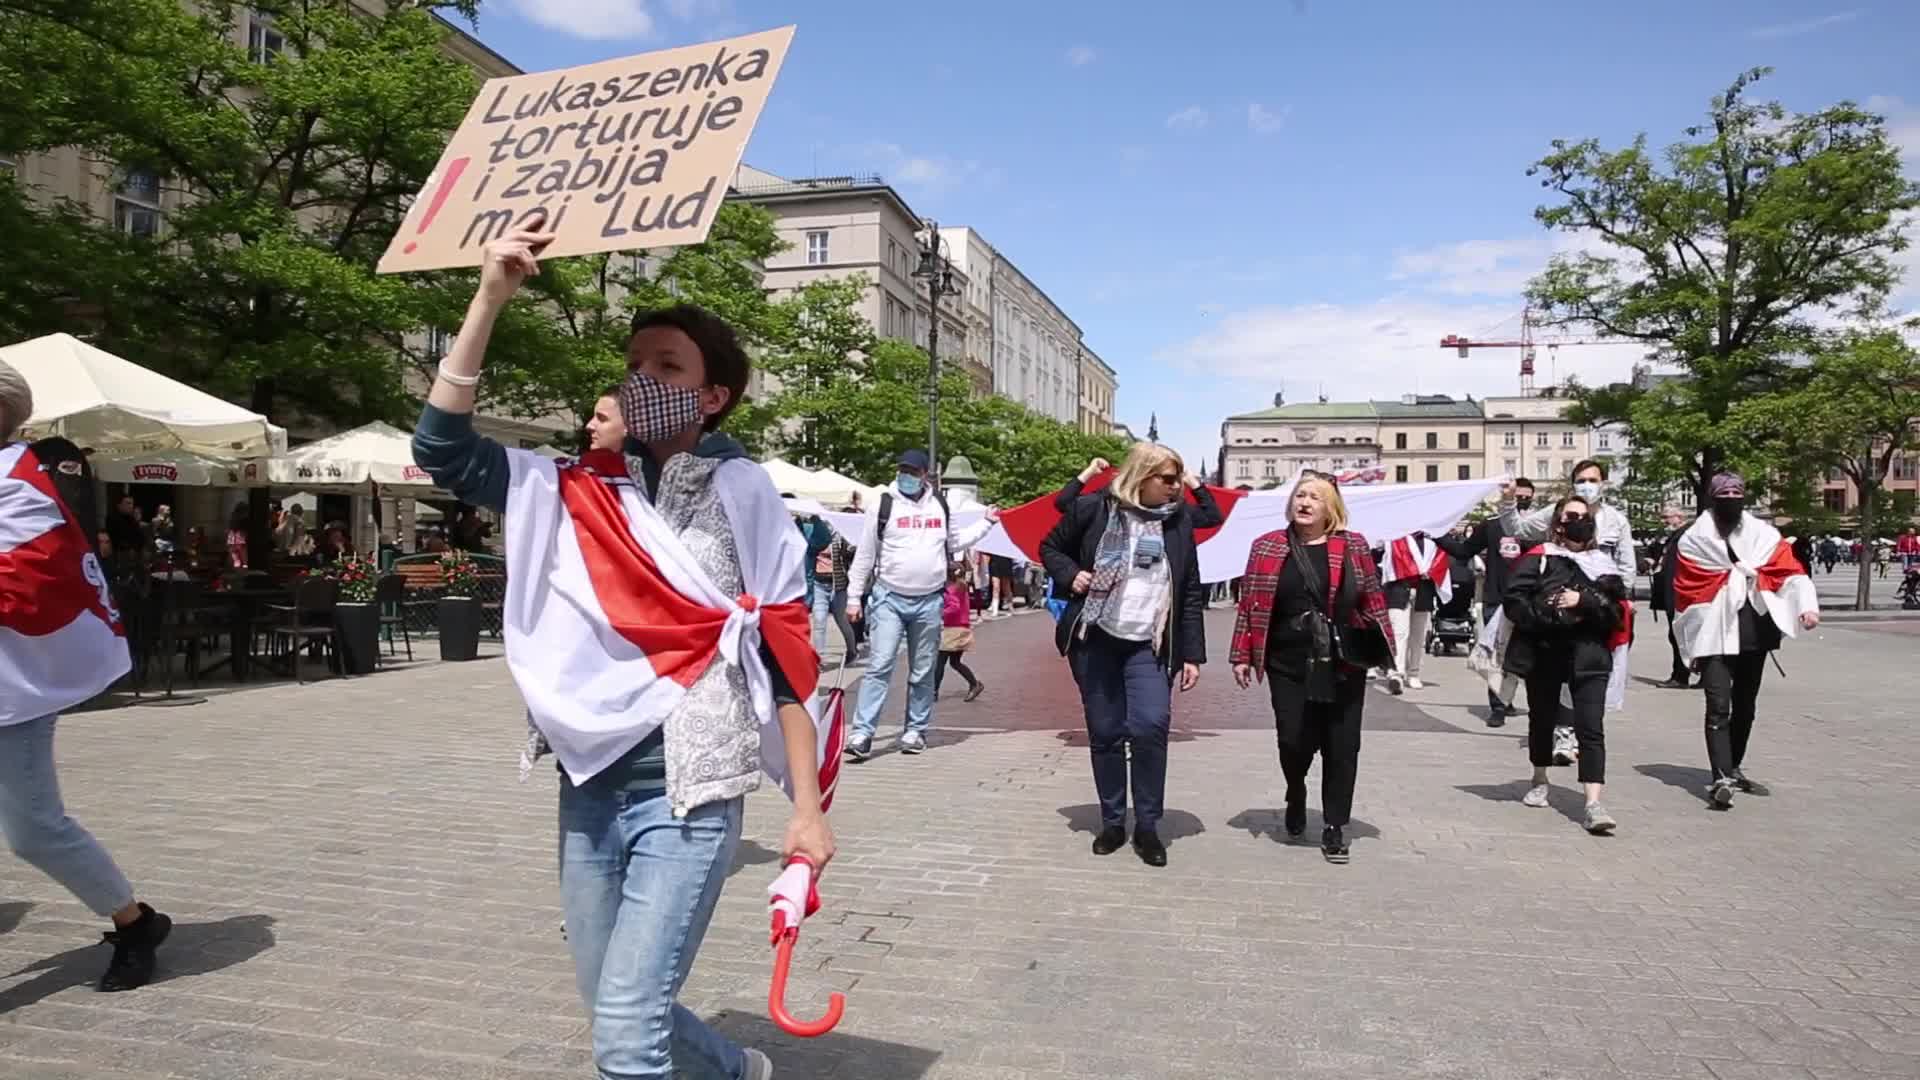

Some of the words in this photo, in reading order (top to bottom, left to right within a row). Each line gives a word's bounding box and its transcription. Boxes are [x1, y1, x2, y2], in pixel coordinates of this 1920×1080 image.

[482, 46, 770, 124] Lukaszenka
[488, 91, 743, 164] torturuje
[472, 167, 496, 201] i
[501, 148, 669, 204] zabija
[601, 176, 717, 238] Lud
